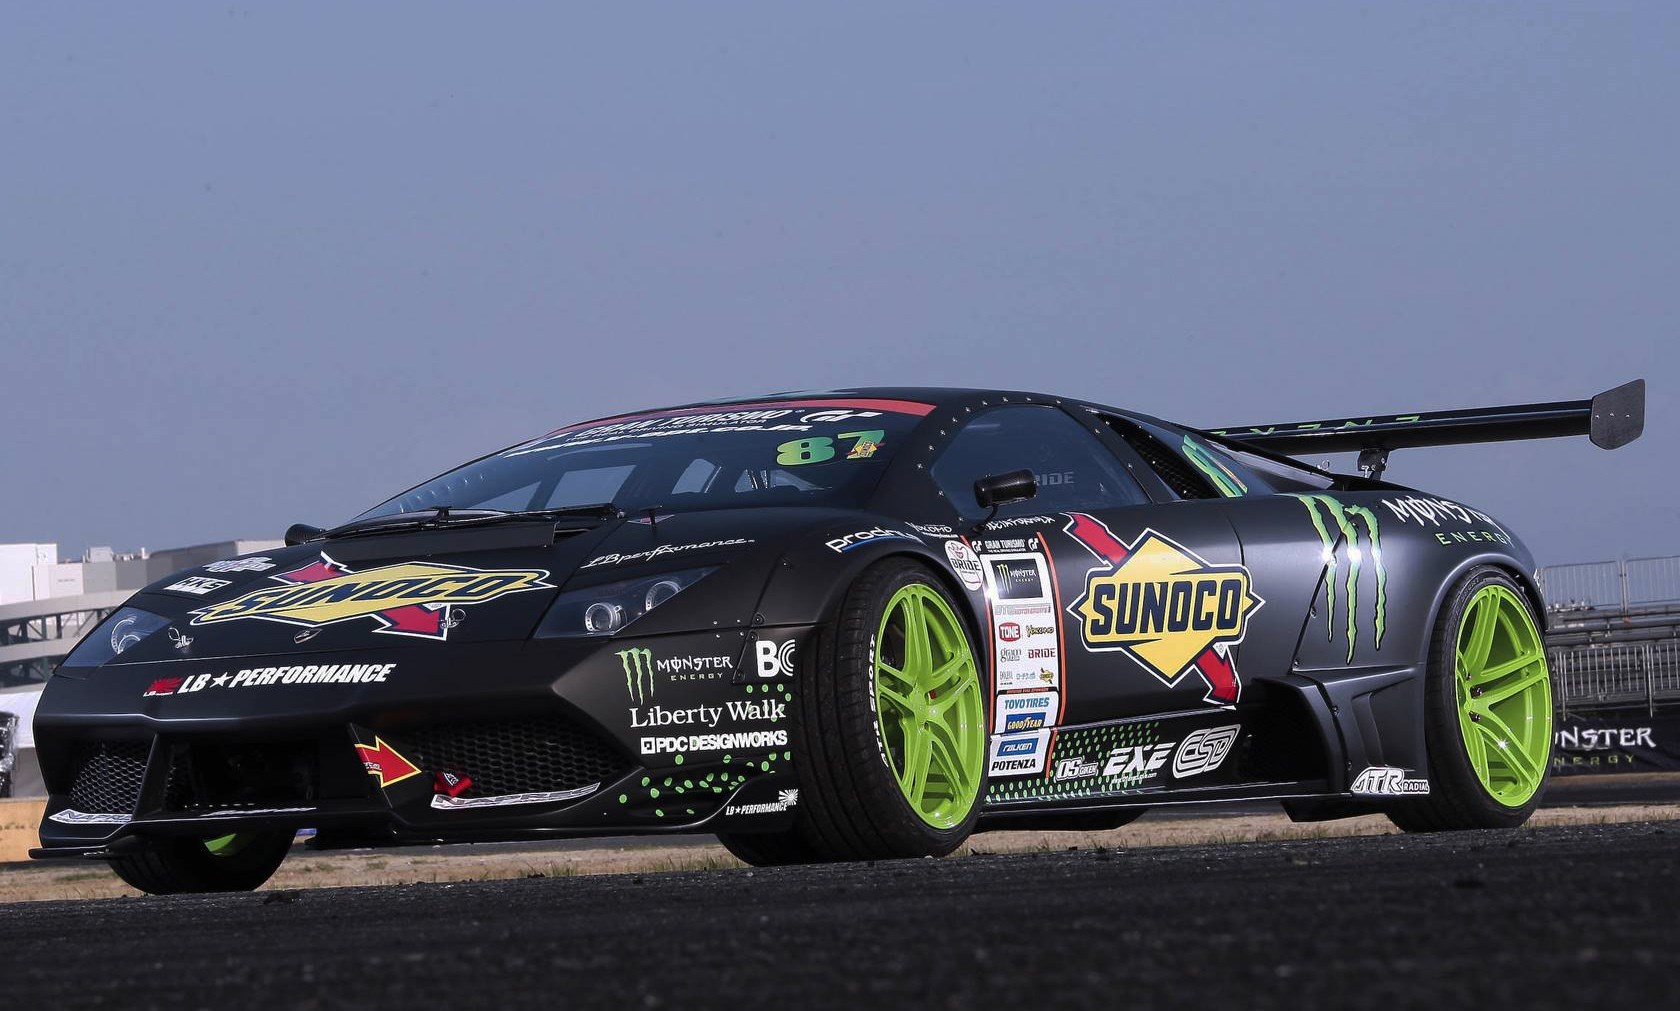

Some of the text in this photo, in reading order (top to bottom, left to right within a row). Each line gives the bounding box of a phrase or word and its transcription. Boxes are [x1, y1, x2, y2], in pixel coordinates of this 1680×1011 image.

[777, 429, 885, 466] 87
[1381, 495, 1511, 540] MONS
[951, 558, 981, 571] BRIDE
[210, 574, 531, 617] SUNOCO
[1091, 579, 1242, 635] SUNOCO
[1000, 625, 1020, 638] TONE
[1027, 647, 1057, 659] BRIDE
[657, 655, 734, 673] MONSTER
[228, 663, 397, 688] PERFORMANCE
[670, 672, 724, 682] ENERGY
[629, 699, 787, 728] Liberty Walk
[1004, 697, 1050, 710] TOYO TIRES
[1007, 717, 1043, 730] GOODYEAR
[656, 729, 788, 753] PDC DESIGNWORKS
[1554, 725, 1657, 751] NSTER
[991, 758, 1036, 771] POTENZA
[1102, 741, 1177, 776] EXE
[741, 801, 788, 814] PERFORMANCE
